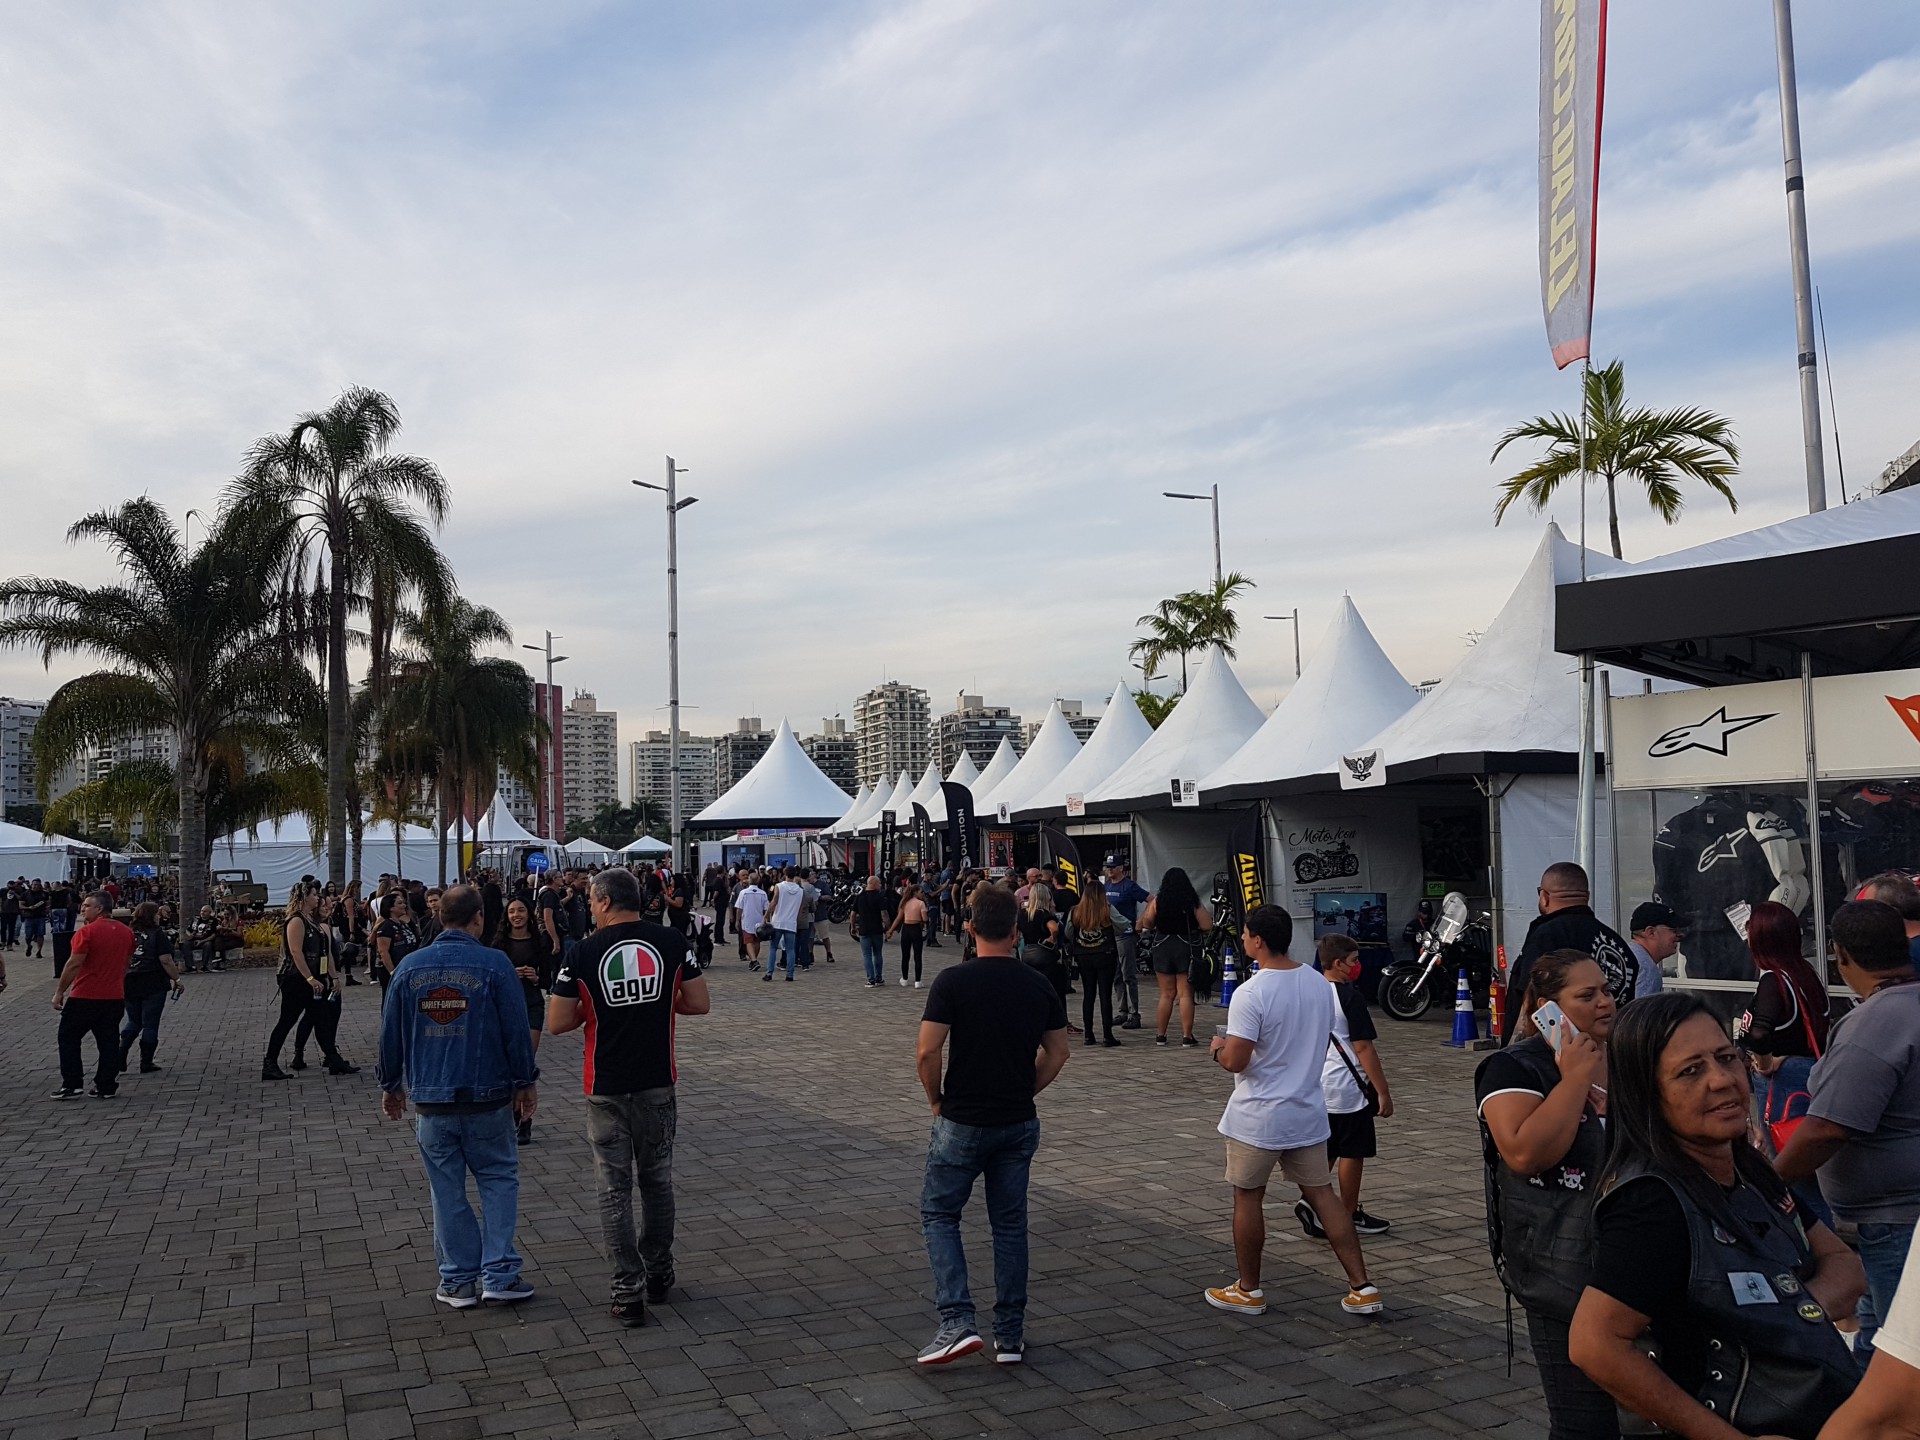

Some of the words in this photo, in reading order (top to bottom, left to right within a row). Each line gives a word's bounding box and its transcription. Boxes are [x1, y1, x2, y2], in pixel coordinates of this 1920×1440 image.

[530, 857, 547, 865] CAIXA
[612, 977, 655, 1003] agv
[422, 1000, 466, 1009] HARLEY-DAVIDSON
